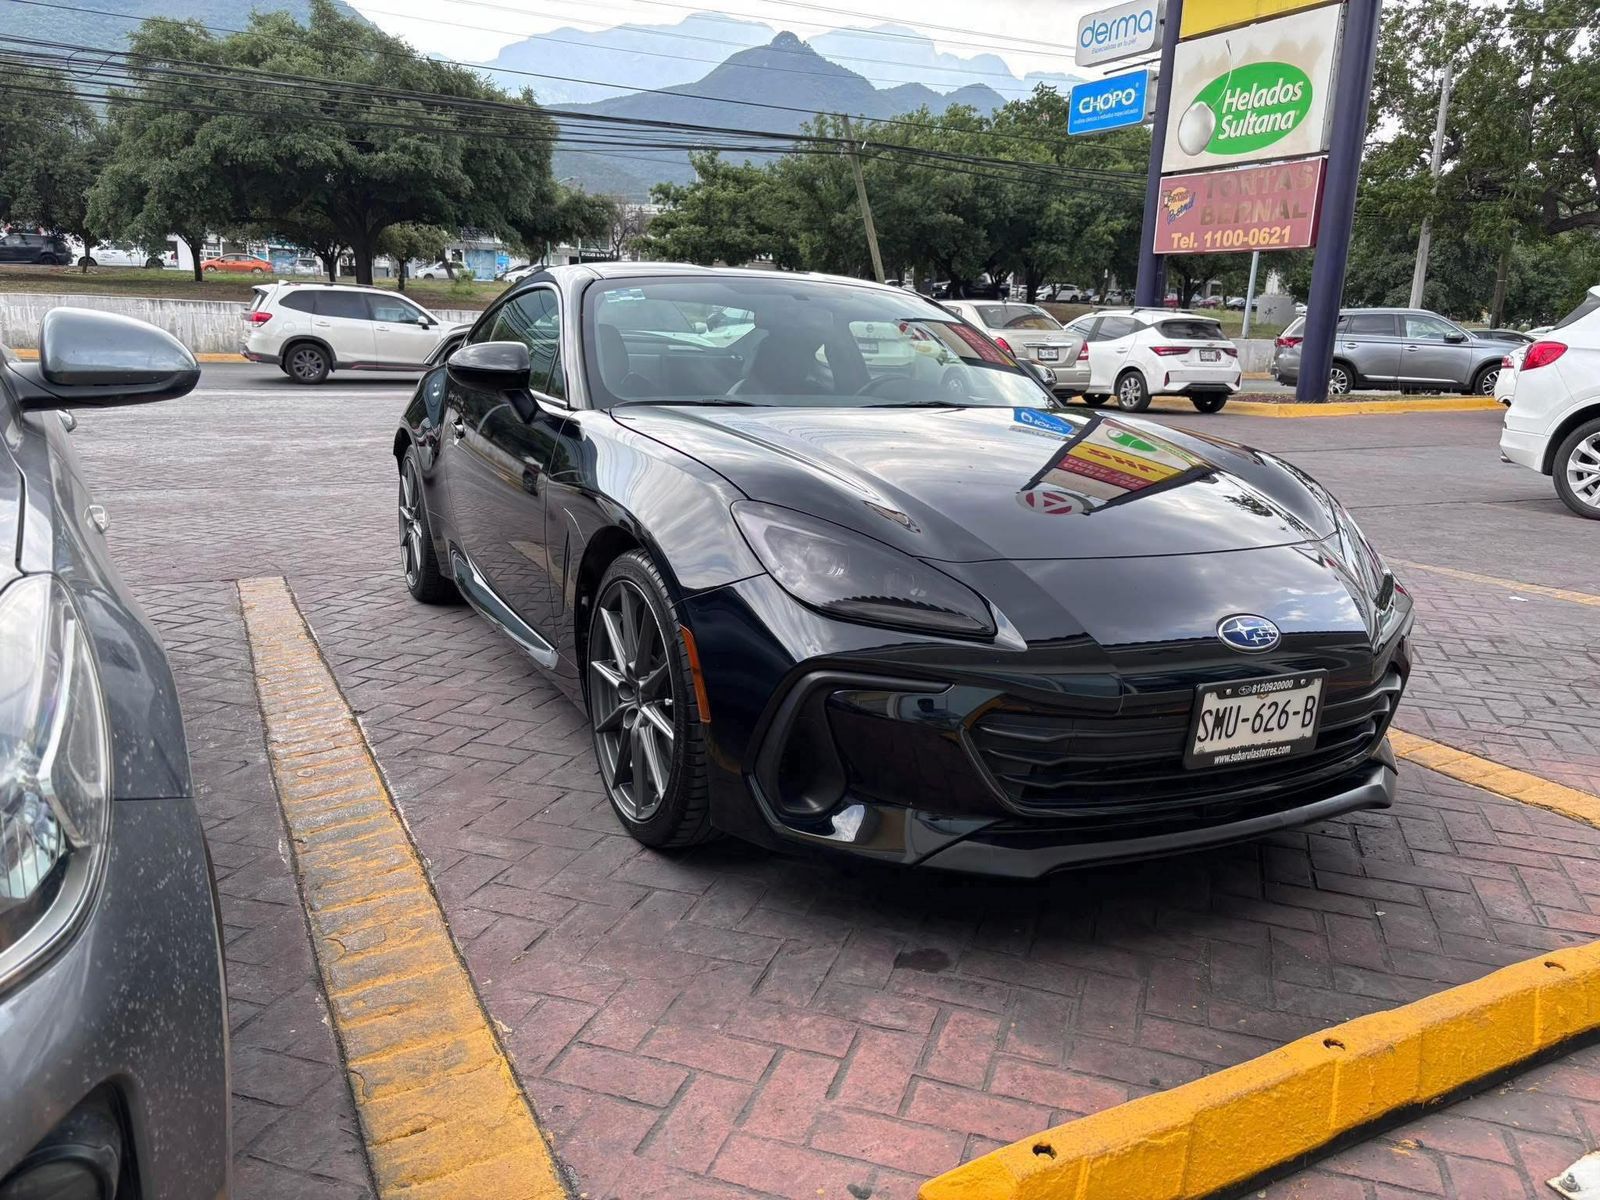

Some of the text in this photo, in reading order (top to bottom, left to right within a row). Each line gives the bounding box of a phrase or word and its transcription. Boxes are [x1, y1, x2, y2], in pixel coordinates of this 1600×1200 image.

[1080, 9, 1153, 48] derma
[1078, 87, 1136, 114] CHOPO
[1221, 78, 1303, 114] Helados
[1217, 110, 1295, 140] Sultana
[1204, 164, 1314, 199] TORTAS
[1200, 196, 1309, 226] BERNAL
[1171, 225, 1291, 249] Tel. 1100-0621
[1251, 679, 1294, 694] 8120920000
[1197, 695, 1316, 743] SMU-626-B
[1213, 745, 1291, 765] www.subarulastorres.com
